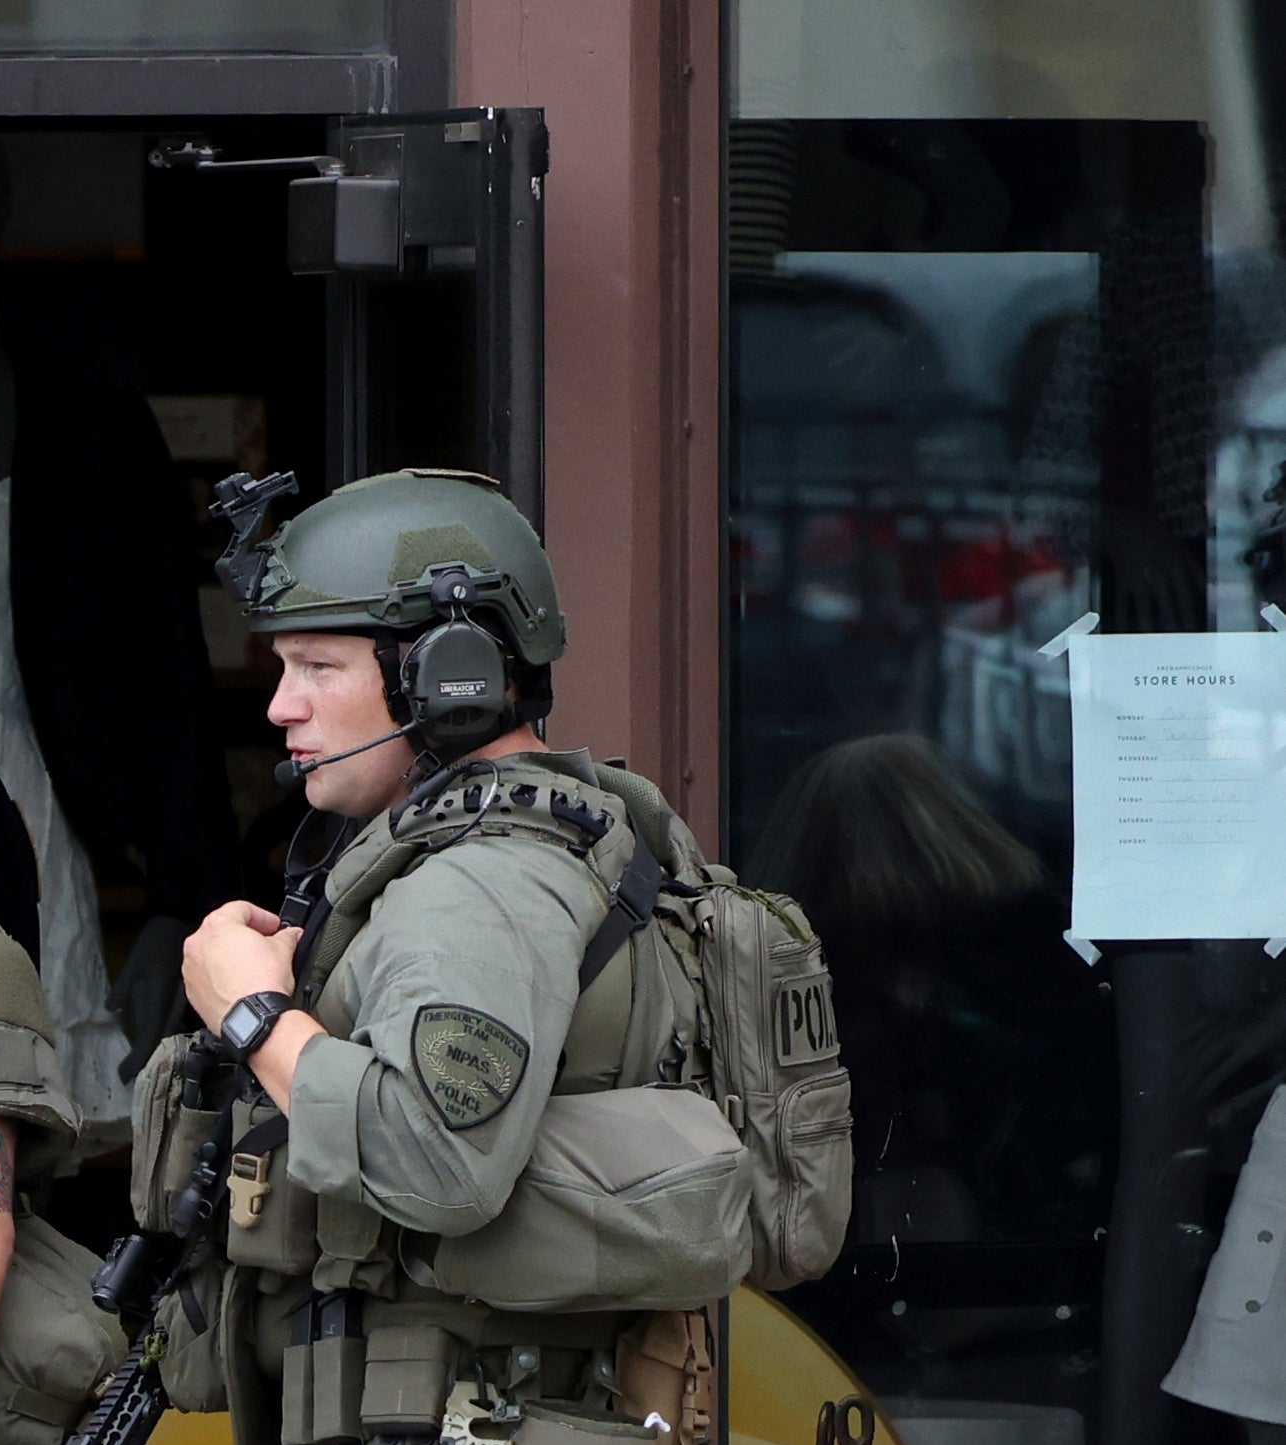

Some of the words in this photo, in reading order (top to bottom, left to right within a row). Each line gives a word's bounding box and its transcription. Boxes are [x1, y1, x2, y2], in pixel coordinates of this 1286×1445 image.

[1134, 675, 1178, 686] STORE
[1186, 675, 1236, 685] HOURS
[463, 1022, 489, 1043] TEAM
[446, 1043, 490, 1075] NIPAS
[433, 1081, 482, 1115] POLICE
